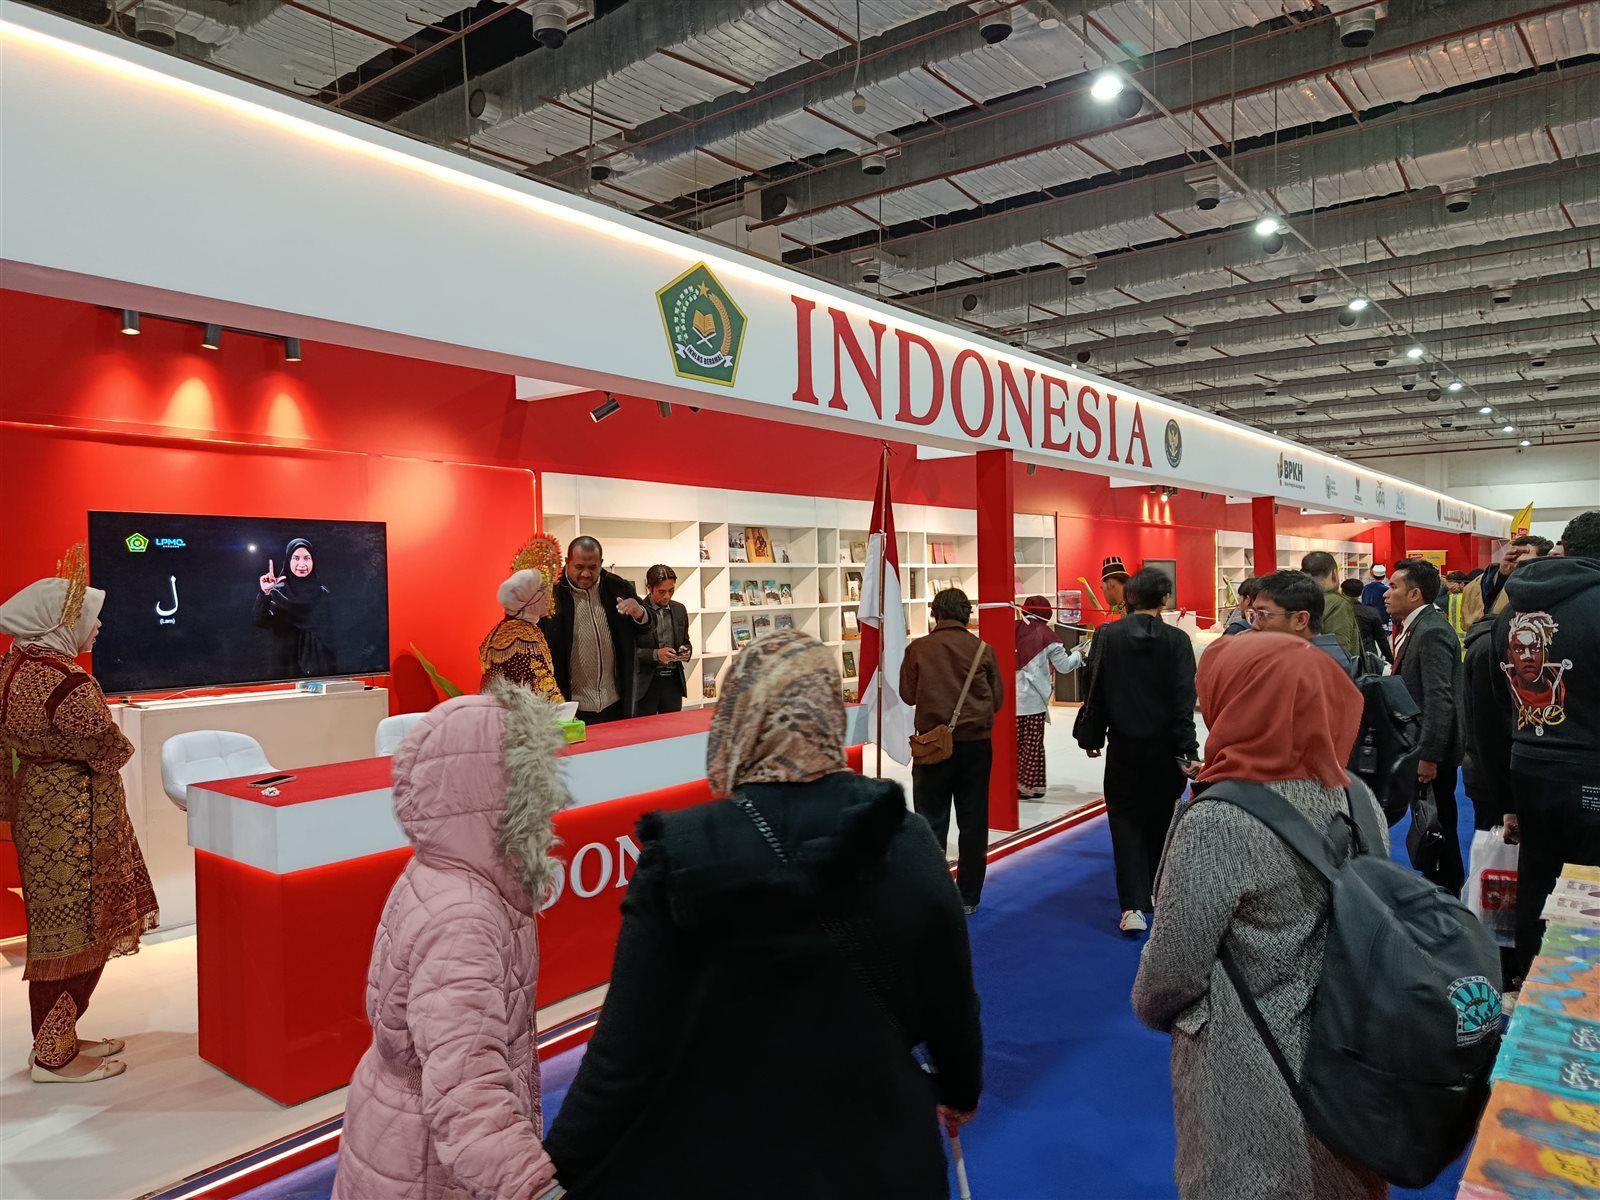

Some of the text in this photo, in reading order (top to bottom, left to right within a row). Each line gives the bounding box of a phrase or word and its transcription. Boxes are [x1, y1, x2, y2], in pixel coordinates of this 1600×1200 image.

[791, 295, 1152, 468] INDONESIA
[1283, 460, 1303, 482] BPKH
[155, 538, 187, 547] LPMQ
[156, 575, 179, 617] ل
